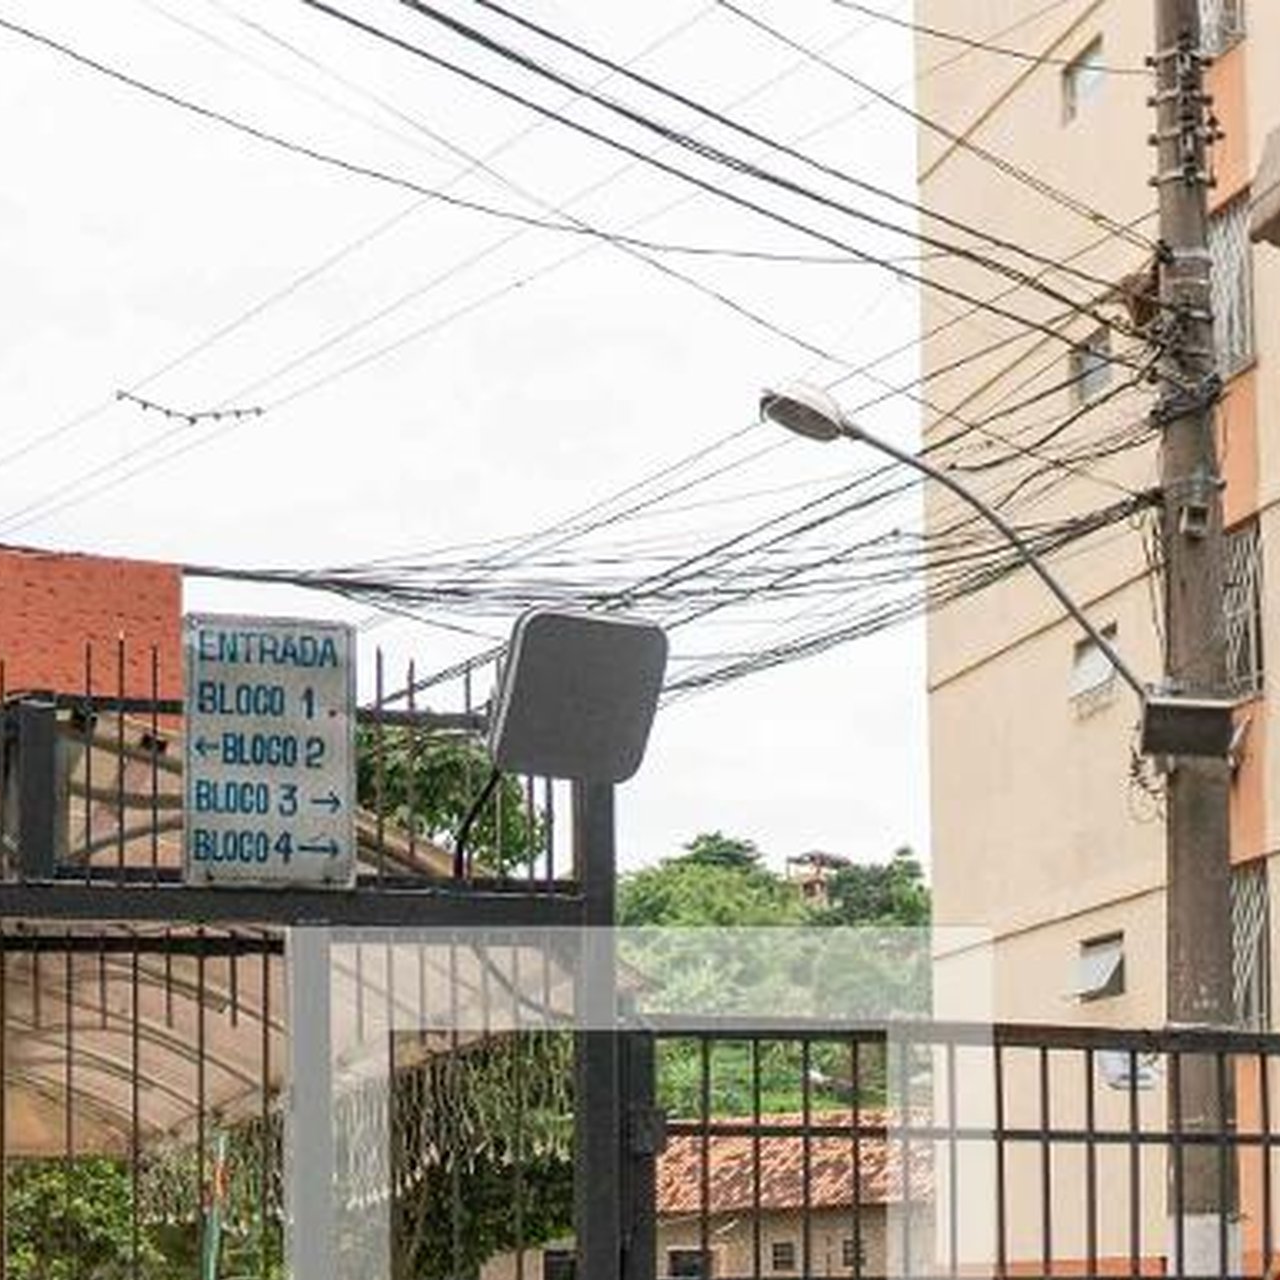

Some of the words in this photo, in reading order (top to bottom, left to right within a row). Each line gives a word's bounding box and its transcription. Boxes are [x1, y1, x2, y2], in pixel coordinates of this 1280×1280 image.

[197, 630, 338, 667] ENTRADA
[197, 681, 284, 716] BLOCO
[302, 686, 314, 718] 1
[222, 732, 297, 767] BLOCO
[306, 737, 325, 768] 2
[195, 779, 269, 814] BLOCO
[278, 784, 298, 816] 3
[193, 829, 269, 862] BLOCO
[273, 830, 294, 864] 4
